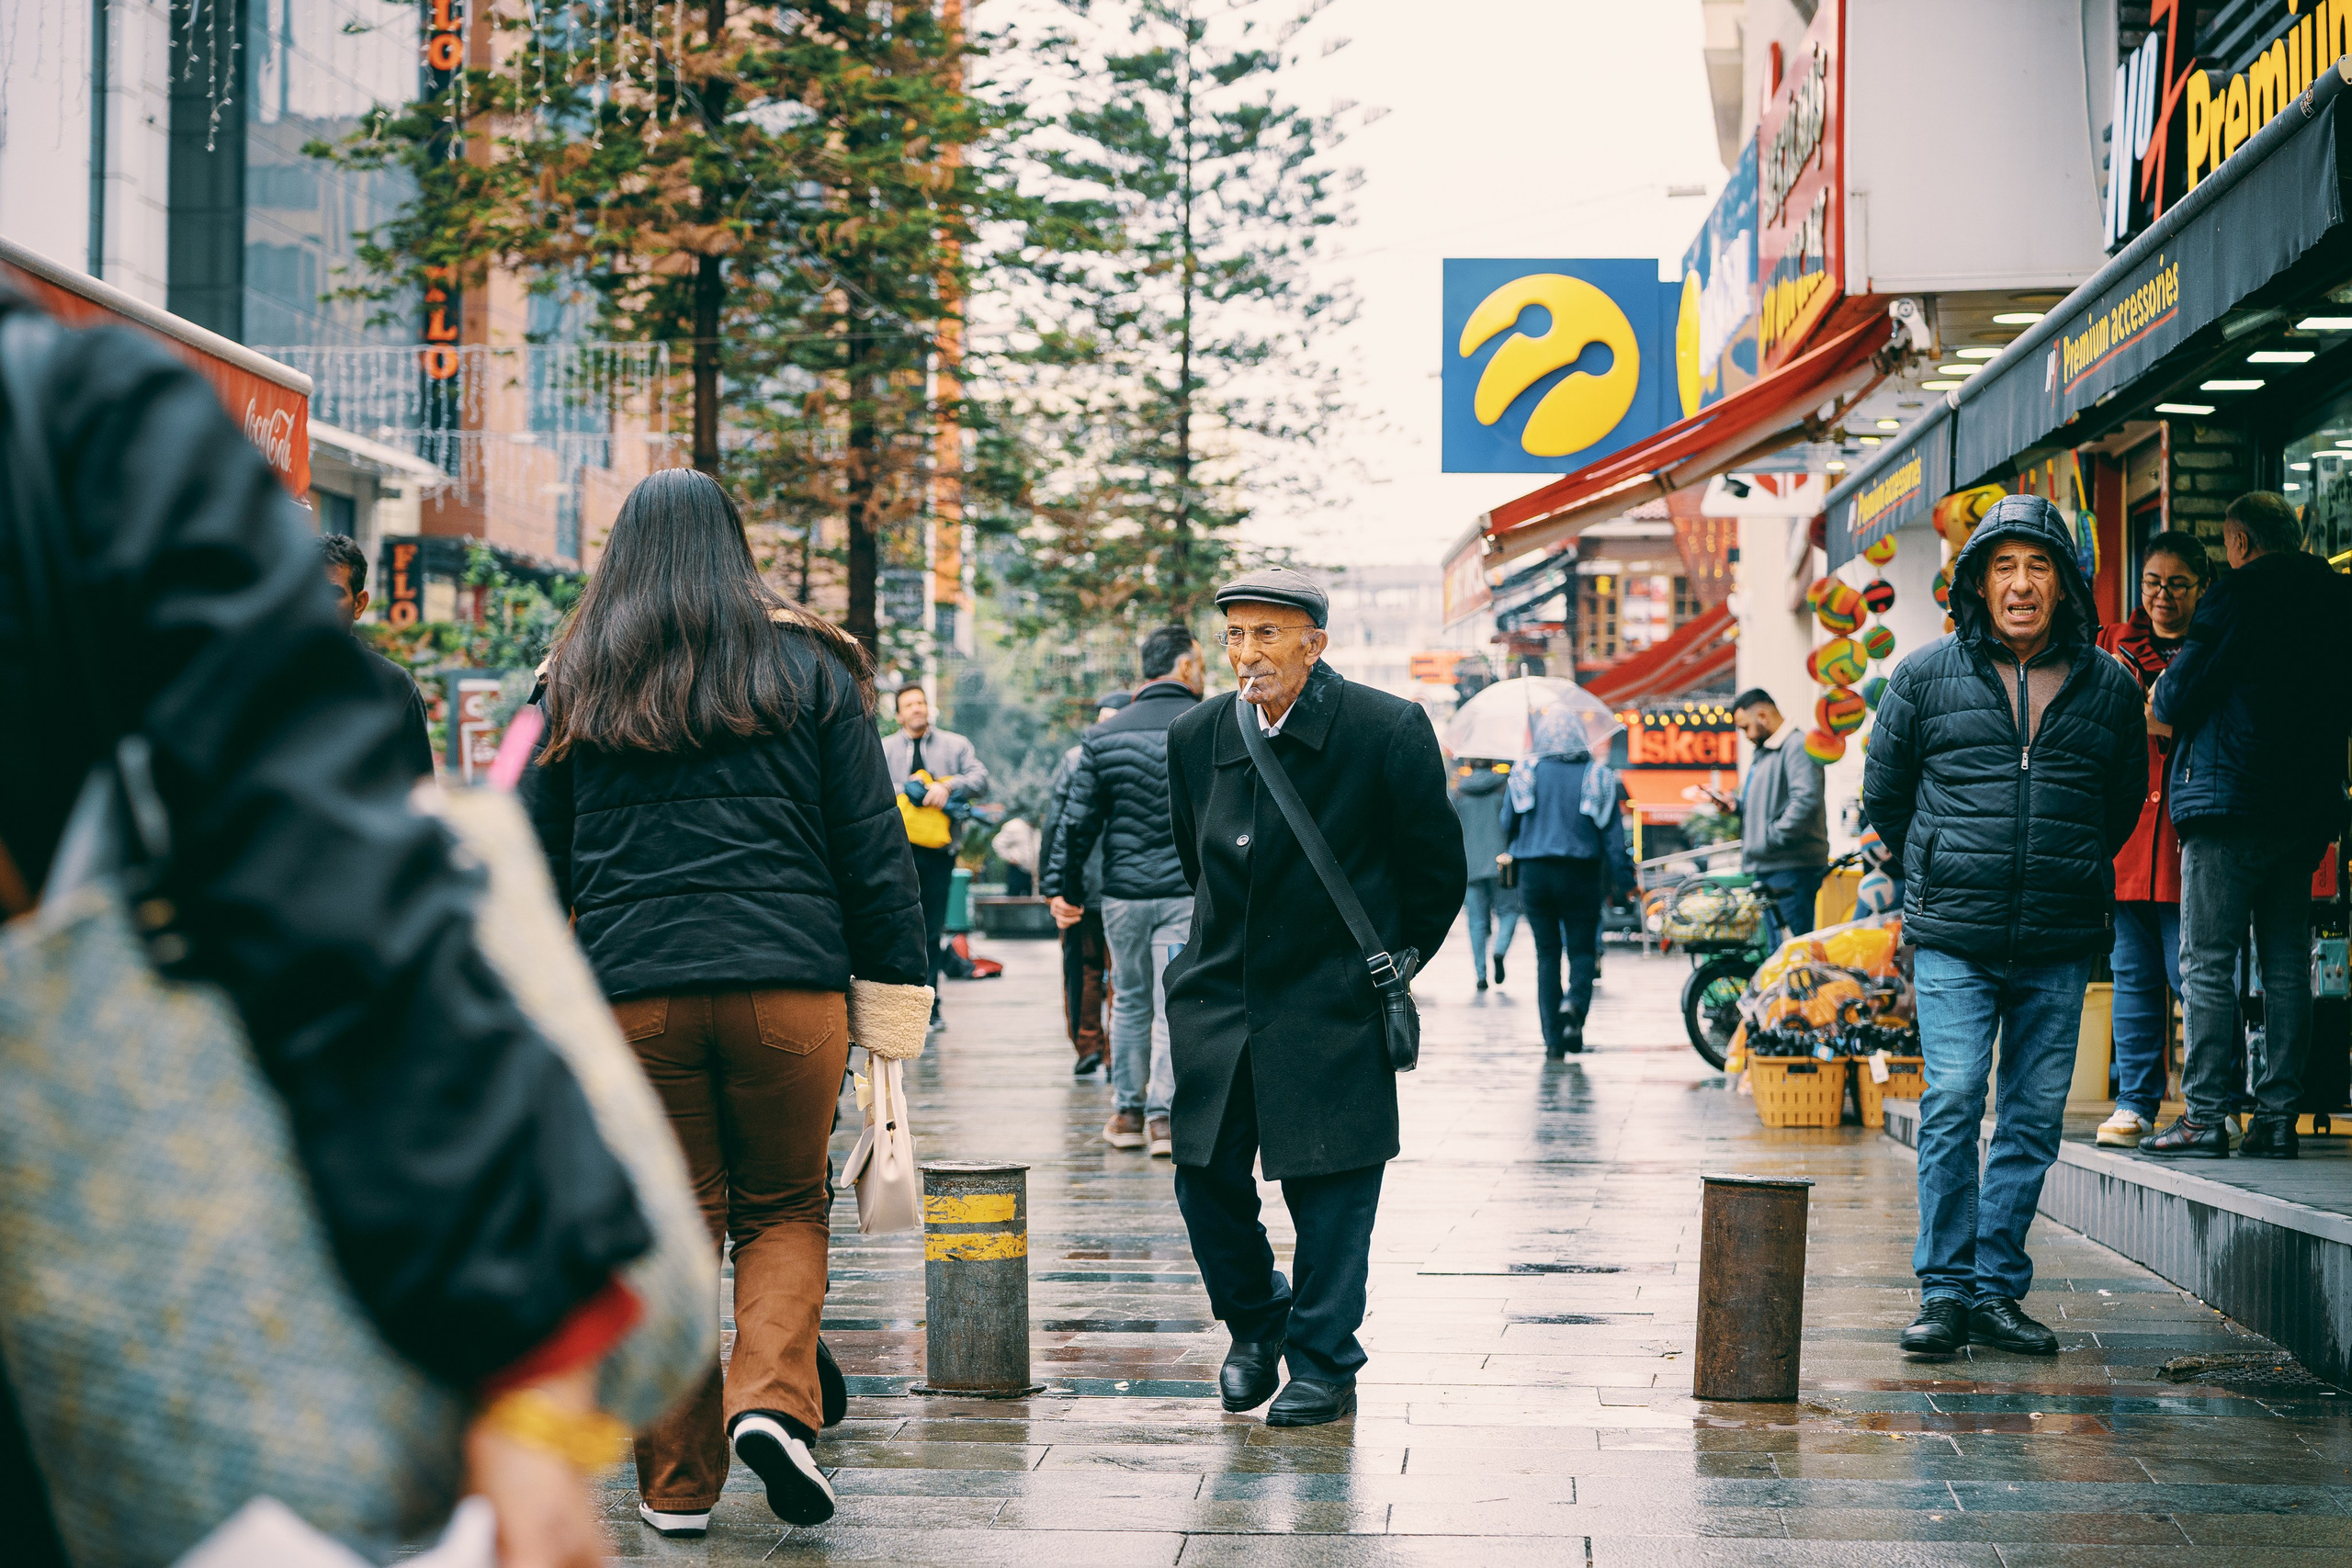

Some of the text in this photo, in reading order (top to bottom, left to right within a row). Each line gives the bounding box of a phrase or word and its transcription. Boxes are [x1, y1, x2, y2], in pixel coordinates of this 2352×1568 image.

[2063, 312, 2109, 384] Premium
[2110, 254, 2179, 345] accessories
[390, 544, 418, 630] FLO
